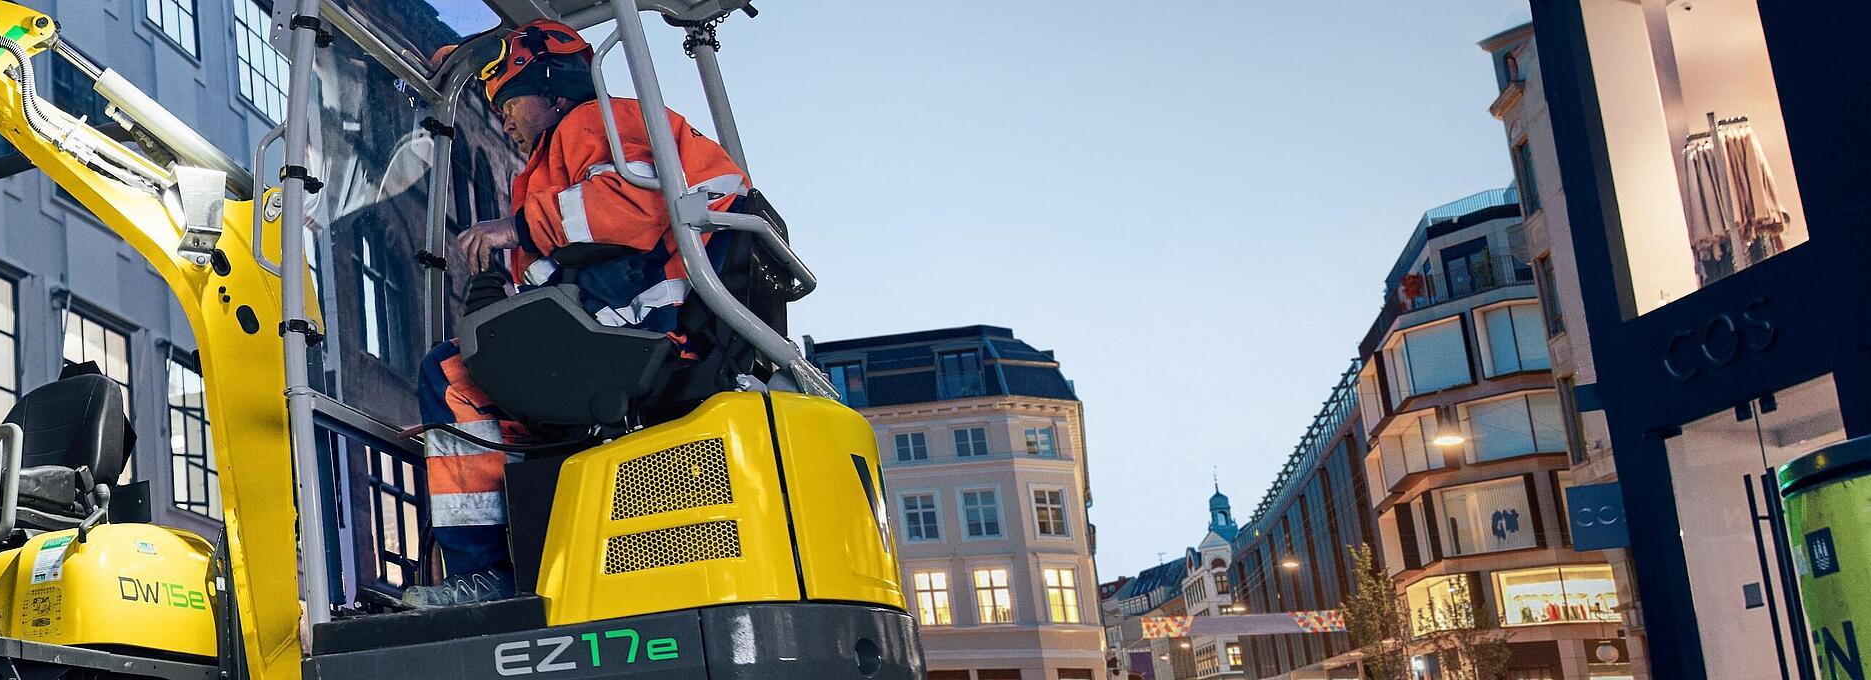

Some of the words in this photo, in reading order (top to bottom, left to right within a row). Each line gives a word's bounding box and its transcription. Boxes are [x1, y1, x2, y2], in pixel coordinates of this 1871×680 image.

[1663, 297, 1774, 382] COS
[1576, 505, 1626, 527] CO
[118, 575, 207, 611] DW15e
[494, 628, 679, 677] EZ17e
